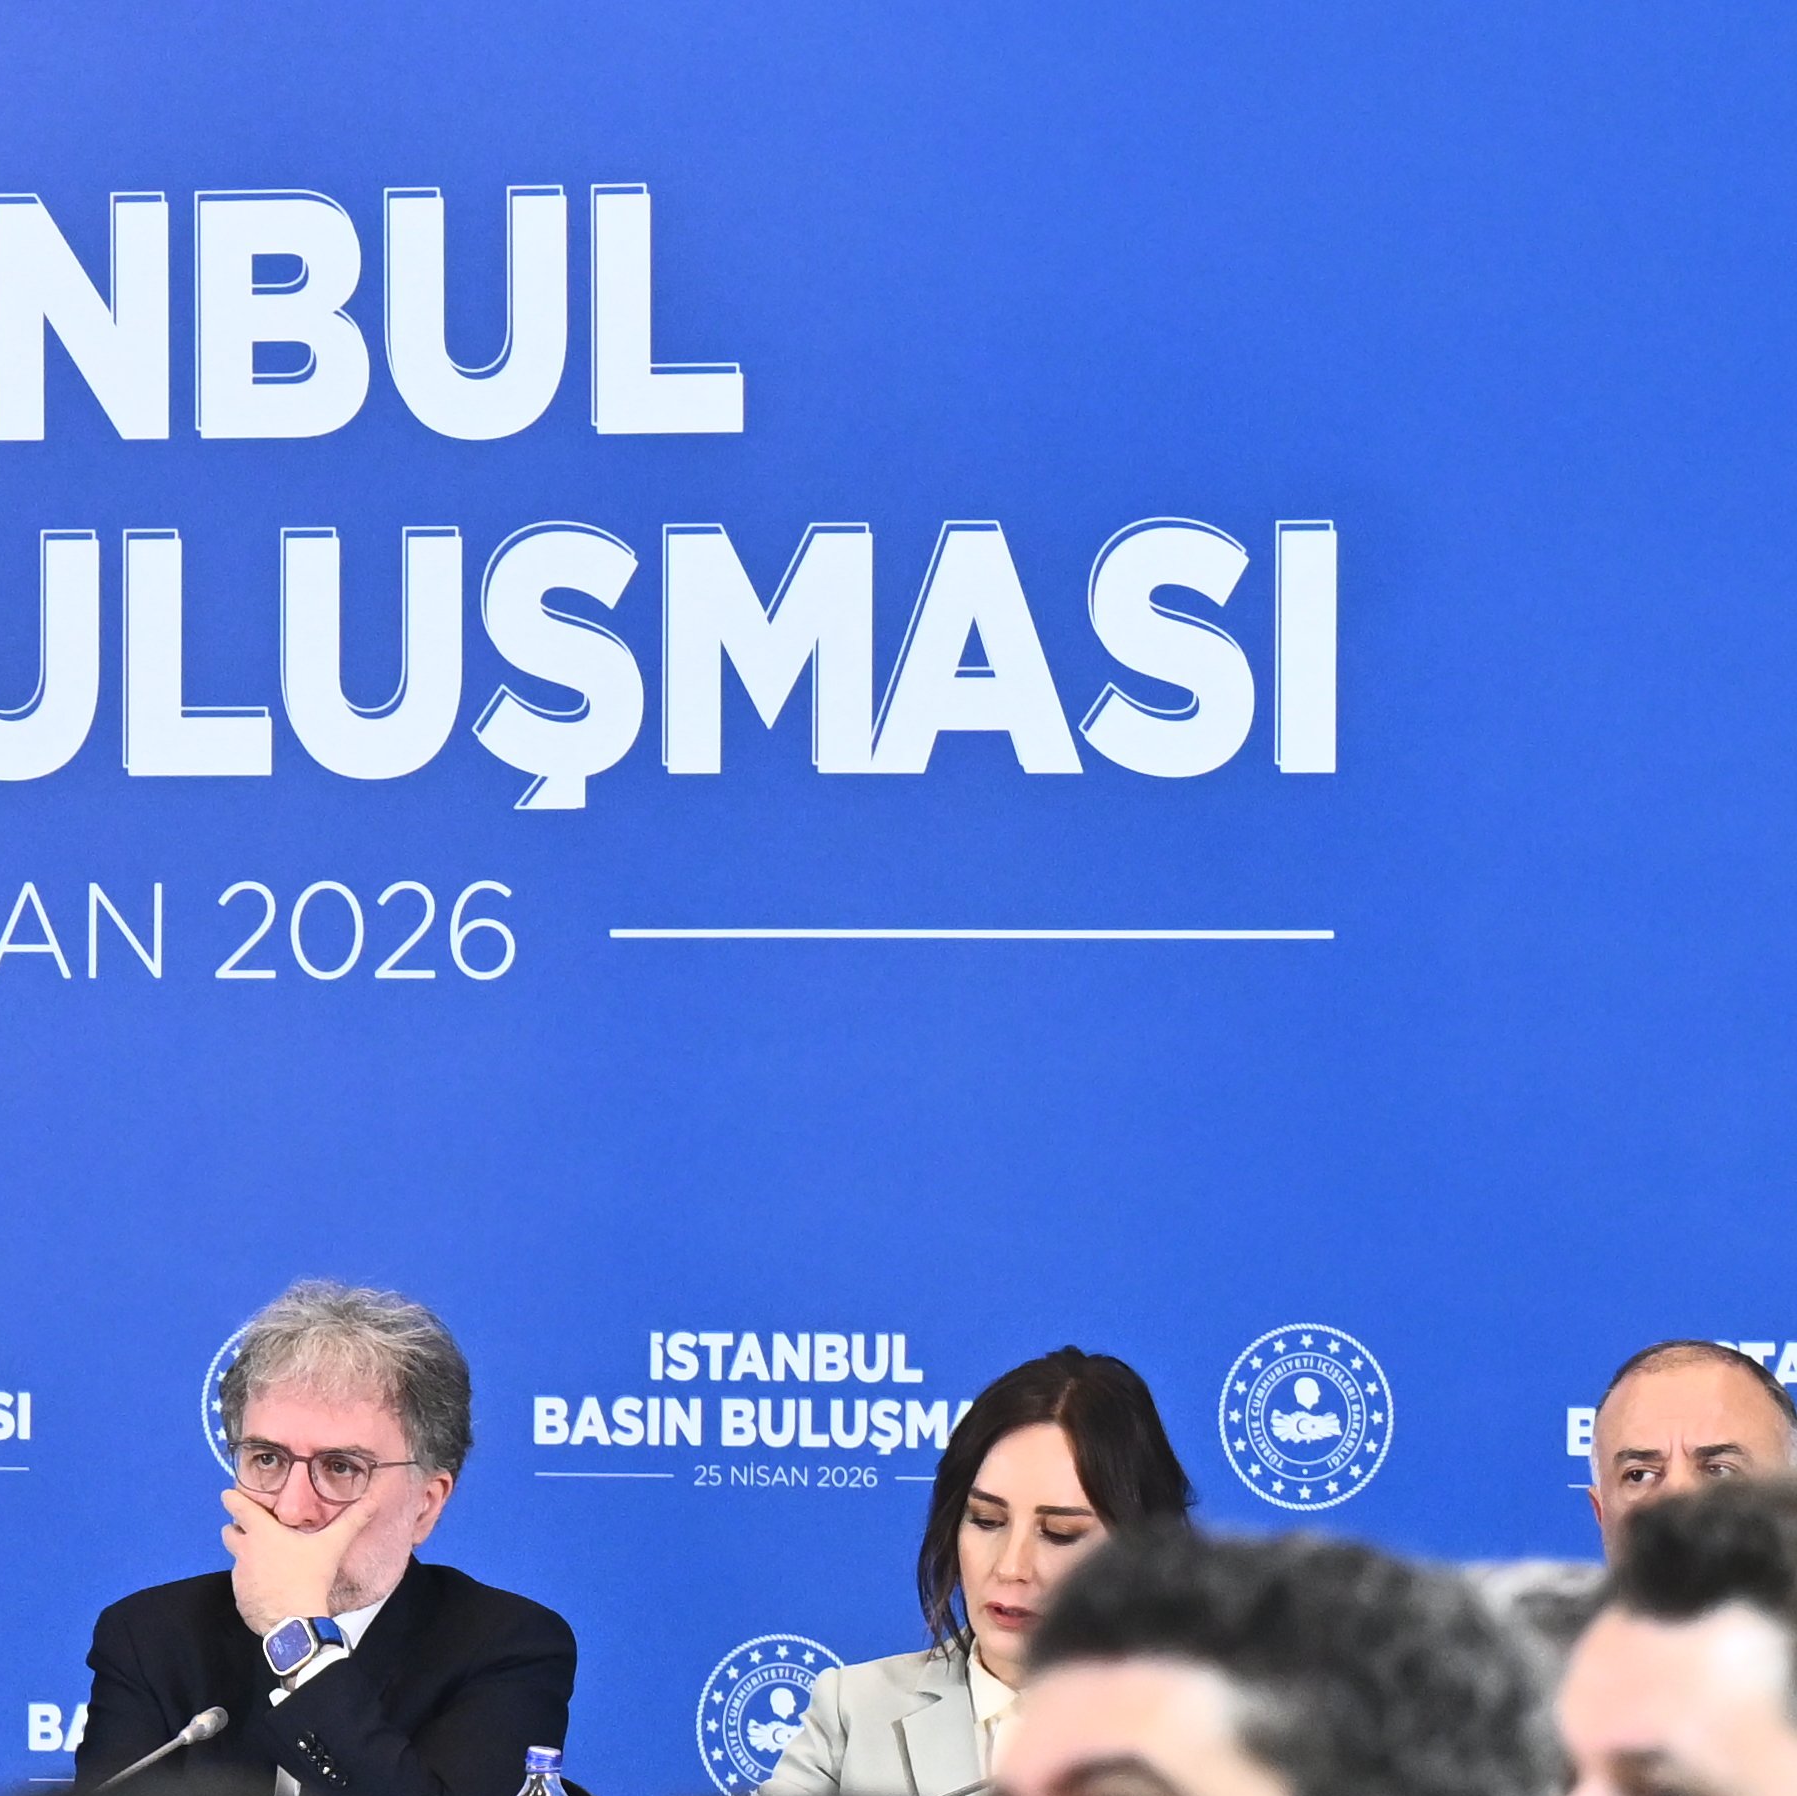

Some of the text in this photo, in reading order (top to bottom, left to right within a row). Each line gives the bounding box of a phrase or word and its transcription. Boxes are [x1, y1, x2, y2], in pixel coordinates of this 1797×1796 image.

[216, 880, 516, 981] 2026
[650, 1331, 924, 1383] İSTANBUL
[533, 1396, 974, 1455] BASIN BULUŞM
[693, 1461, 878, 1488] 25 NİSAN 2026
